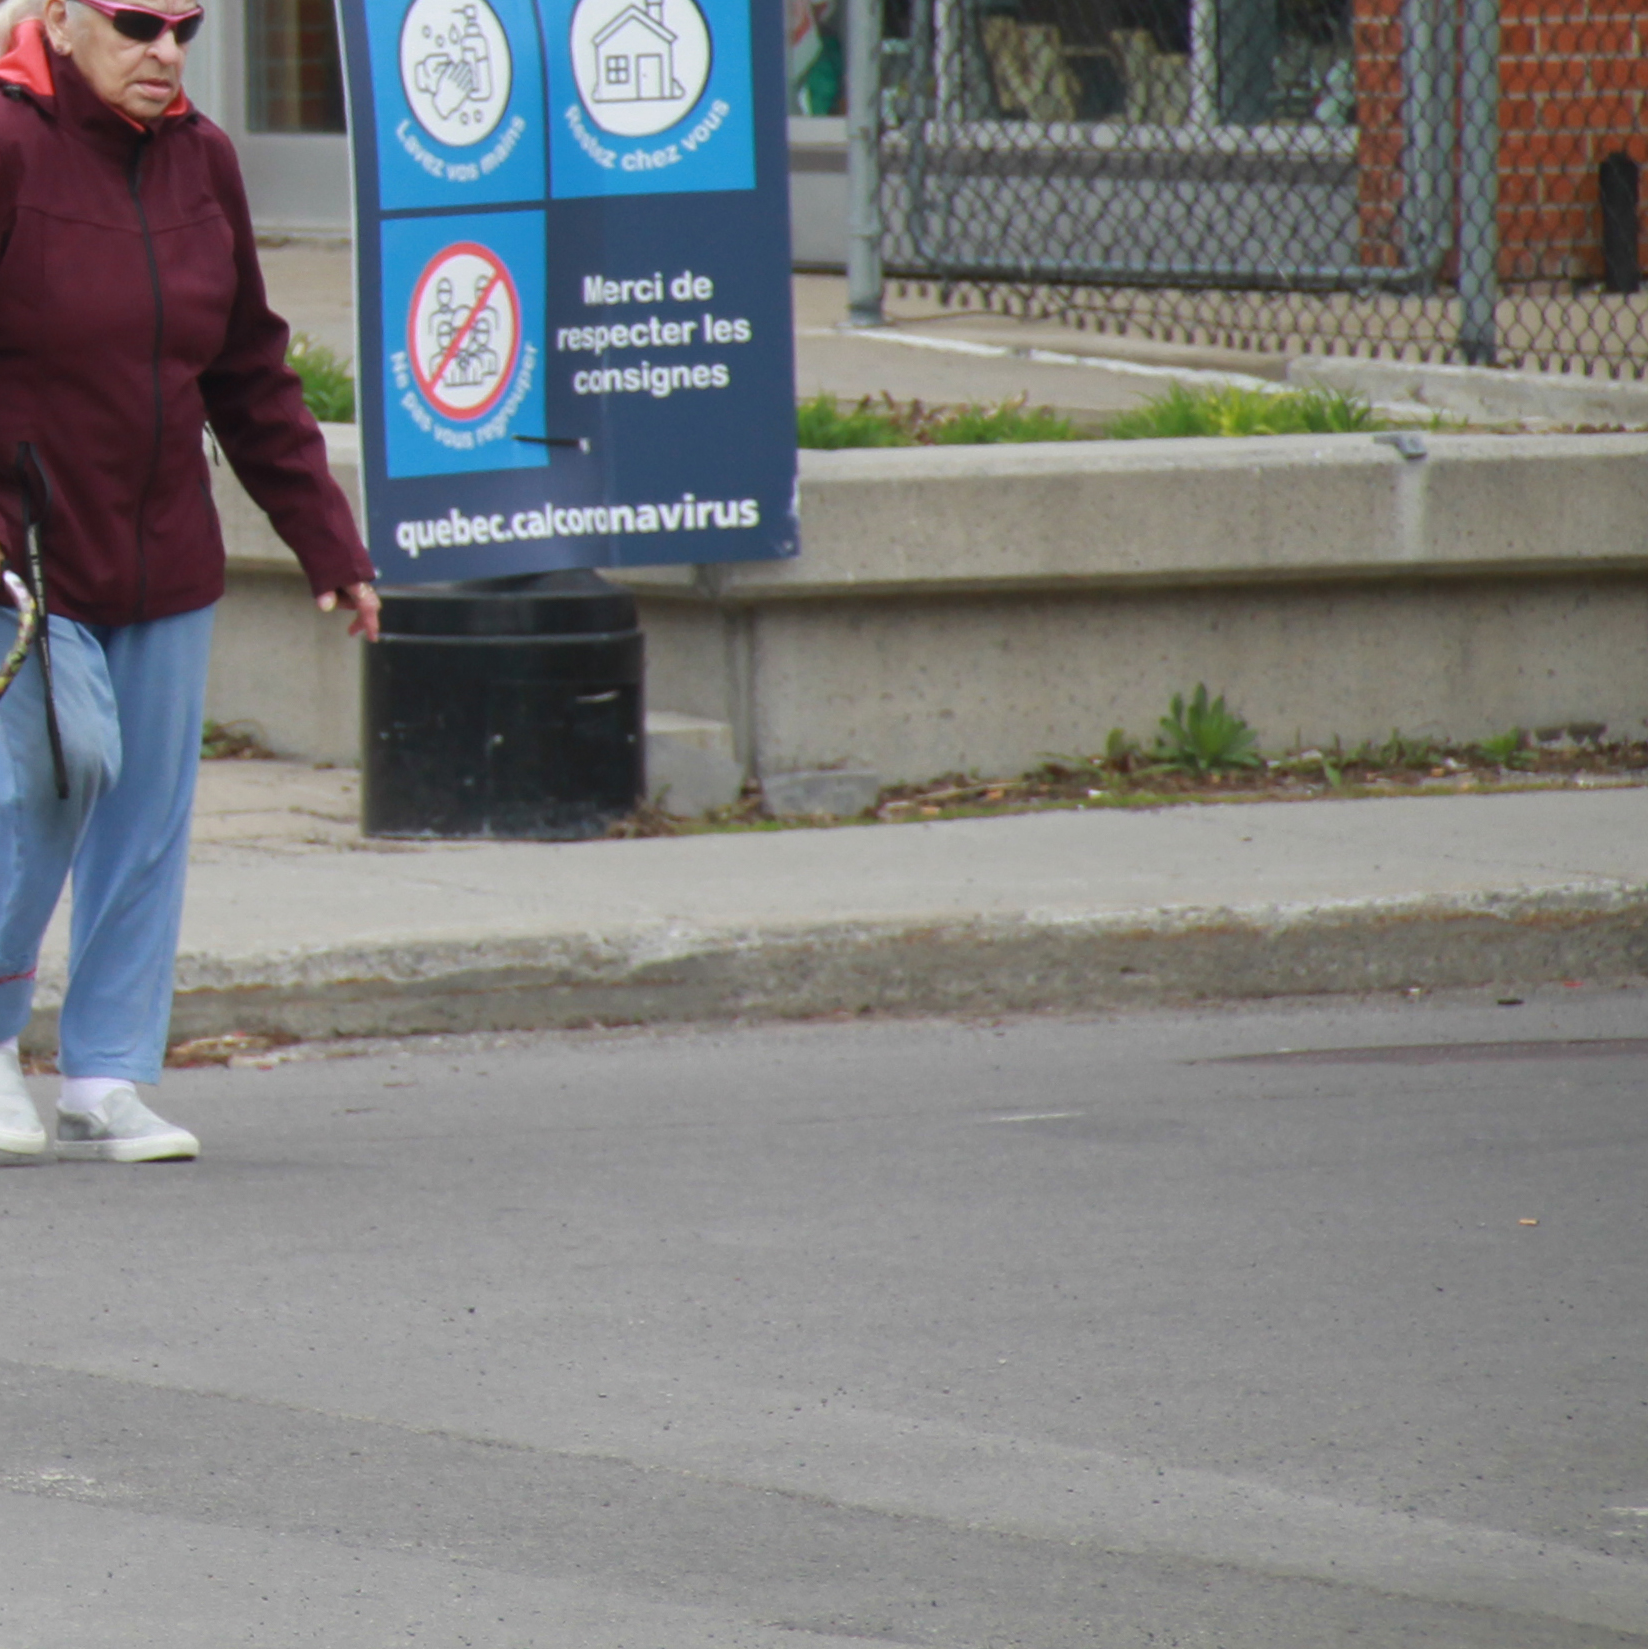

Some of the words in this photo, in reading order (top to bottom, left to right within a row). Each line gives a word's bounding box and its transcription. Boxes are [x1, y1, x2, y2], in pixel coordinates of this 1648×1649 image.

[395, 118, 443, 179] Lavez
[445, 162, 479, 183] vos
[479, 114, 526, 175] mains
[564, 104, 616, 170] Restez
[620, 144, 683, 172] chez
[680, 98, 731, 151] vous
[583, 273, 663, 305] Merci
[670, 270, 713, 302] de
[557, 317, 696, 354] respecter
[704, 314, 751, 343] les
[390, 350, 409, 389] Ne
[401, 391, 433, 432] pas
[433, 424, 475, 449] vous
[475, 341, 537, 446] regrouper
[573, 361, 730, 398] consignes
